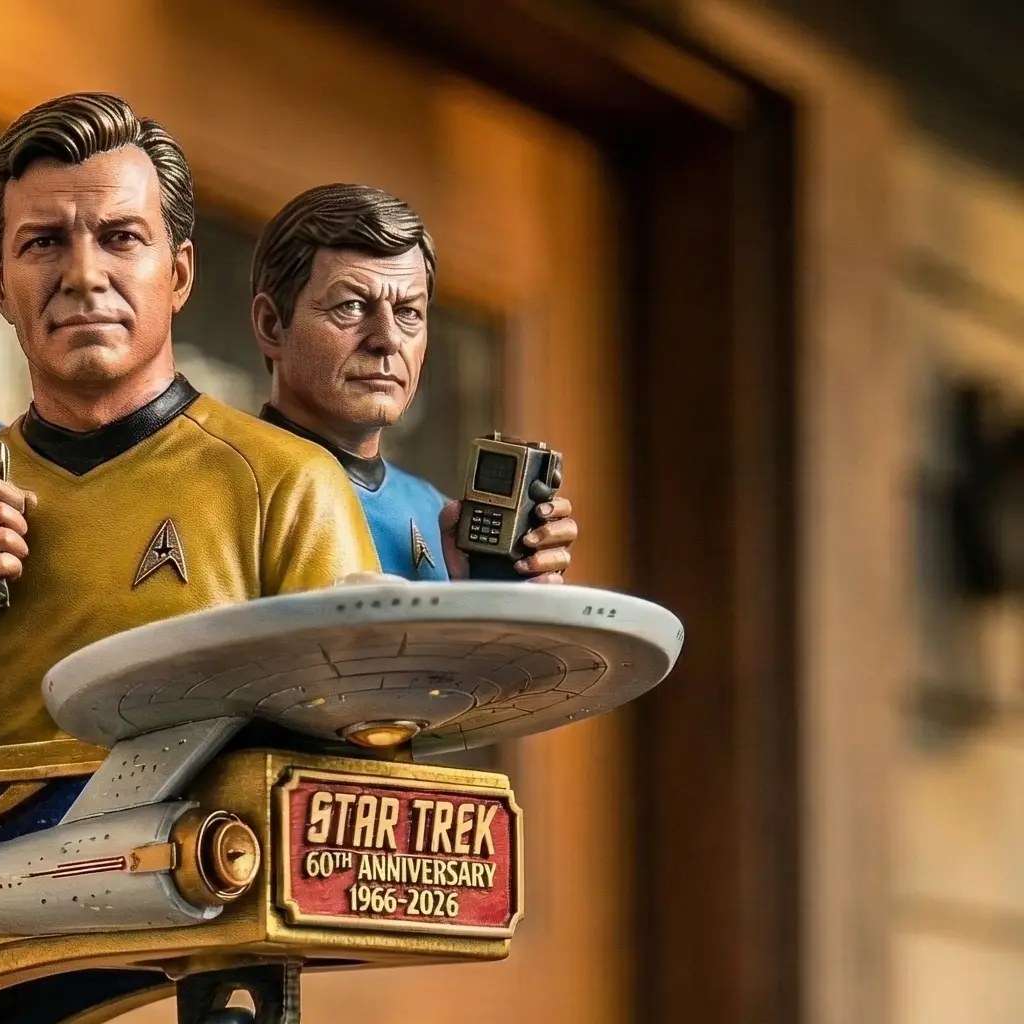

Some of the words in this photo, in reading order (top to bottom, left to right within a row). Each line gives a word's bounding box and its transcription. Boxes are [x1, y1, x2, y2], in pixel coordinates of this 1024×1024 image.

[307, 792, 399, 849] STAR
[413, 800, 497, 855] TREK
[307, 851, 352, 877] 60TH
[358, 855, 496, 887] ANNIVERSARY
[350, 885, 458, 916] 1966-2026
